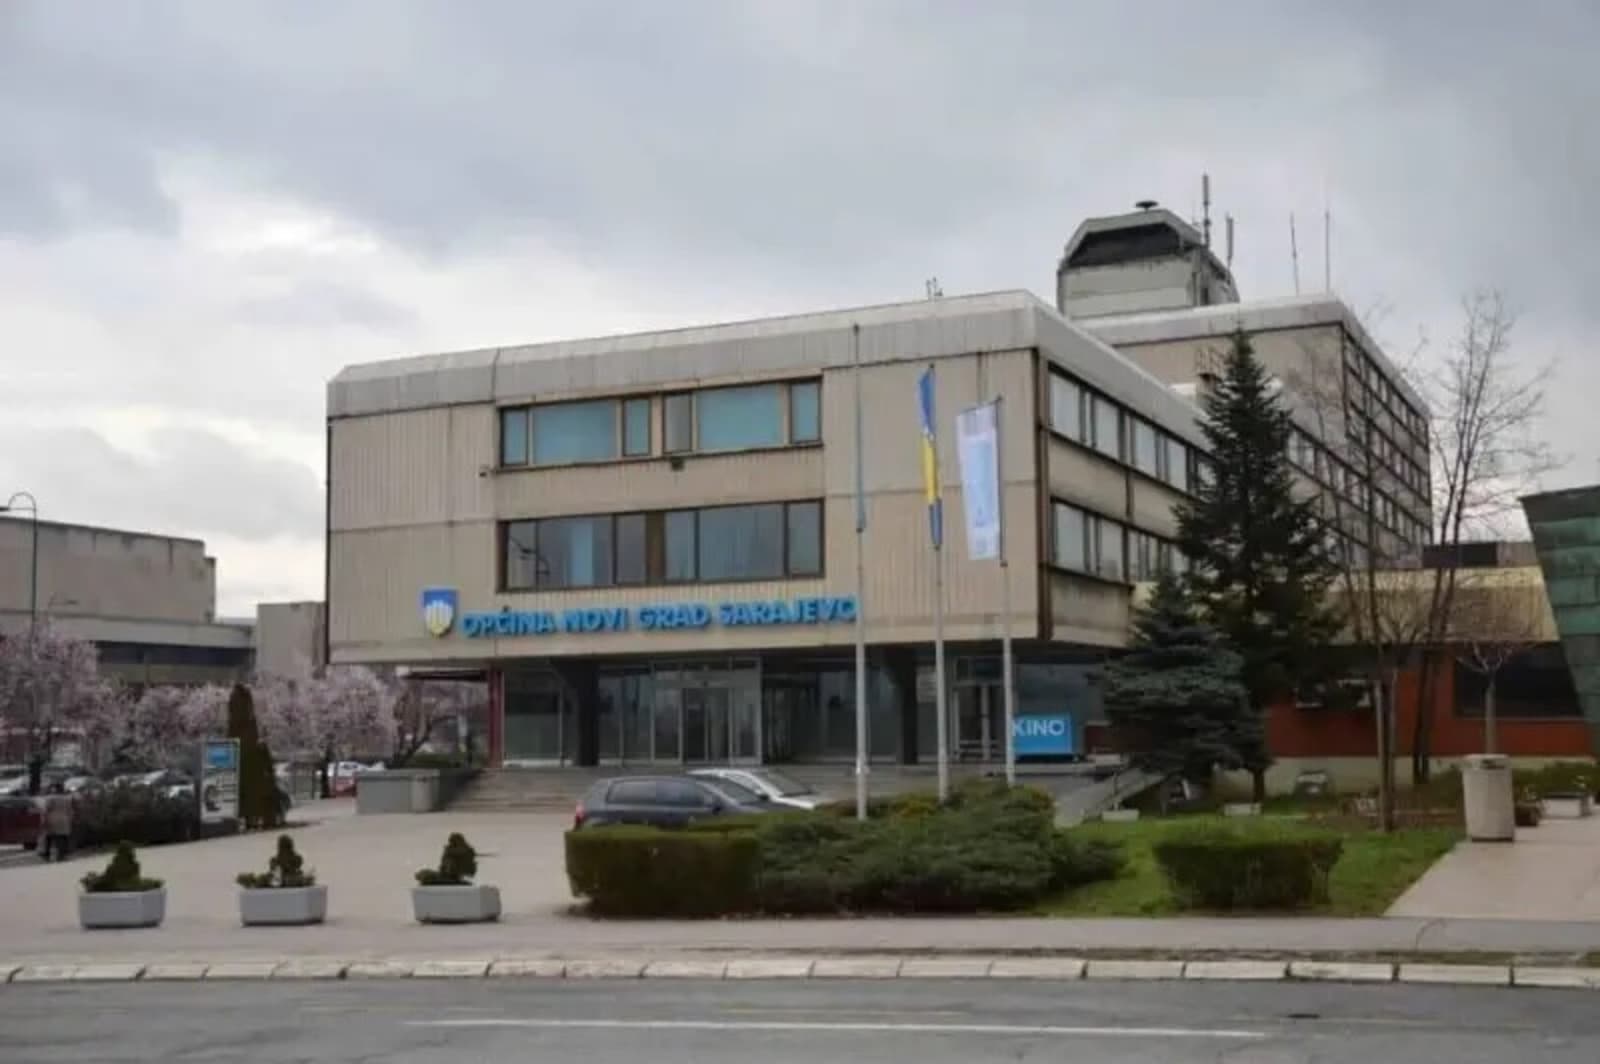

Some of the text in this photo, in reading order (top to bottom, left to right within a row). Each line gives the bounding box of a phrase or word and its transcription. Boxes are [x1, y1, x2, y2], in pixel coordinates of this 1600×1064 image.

[564, 606, 629, 632] NOVI
[638, 603, 711, 631] GRAD
[719, 595, 857, 627] SARAJEVO
[1012, 718, 1065, 737] KINO
